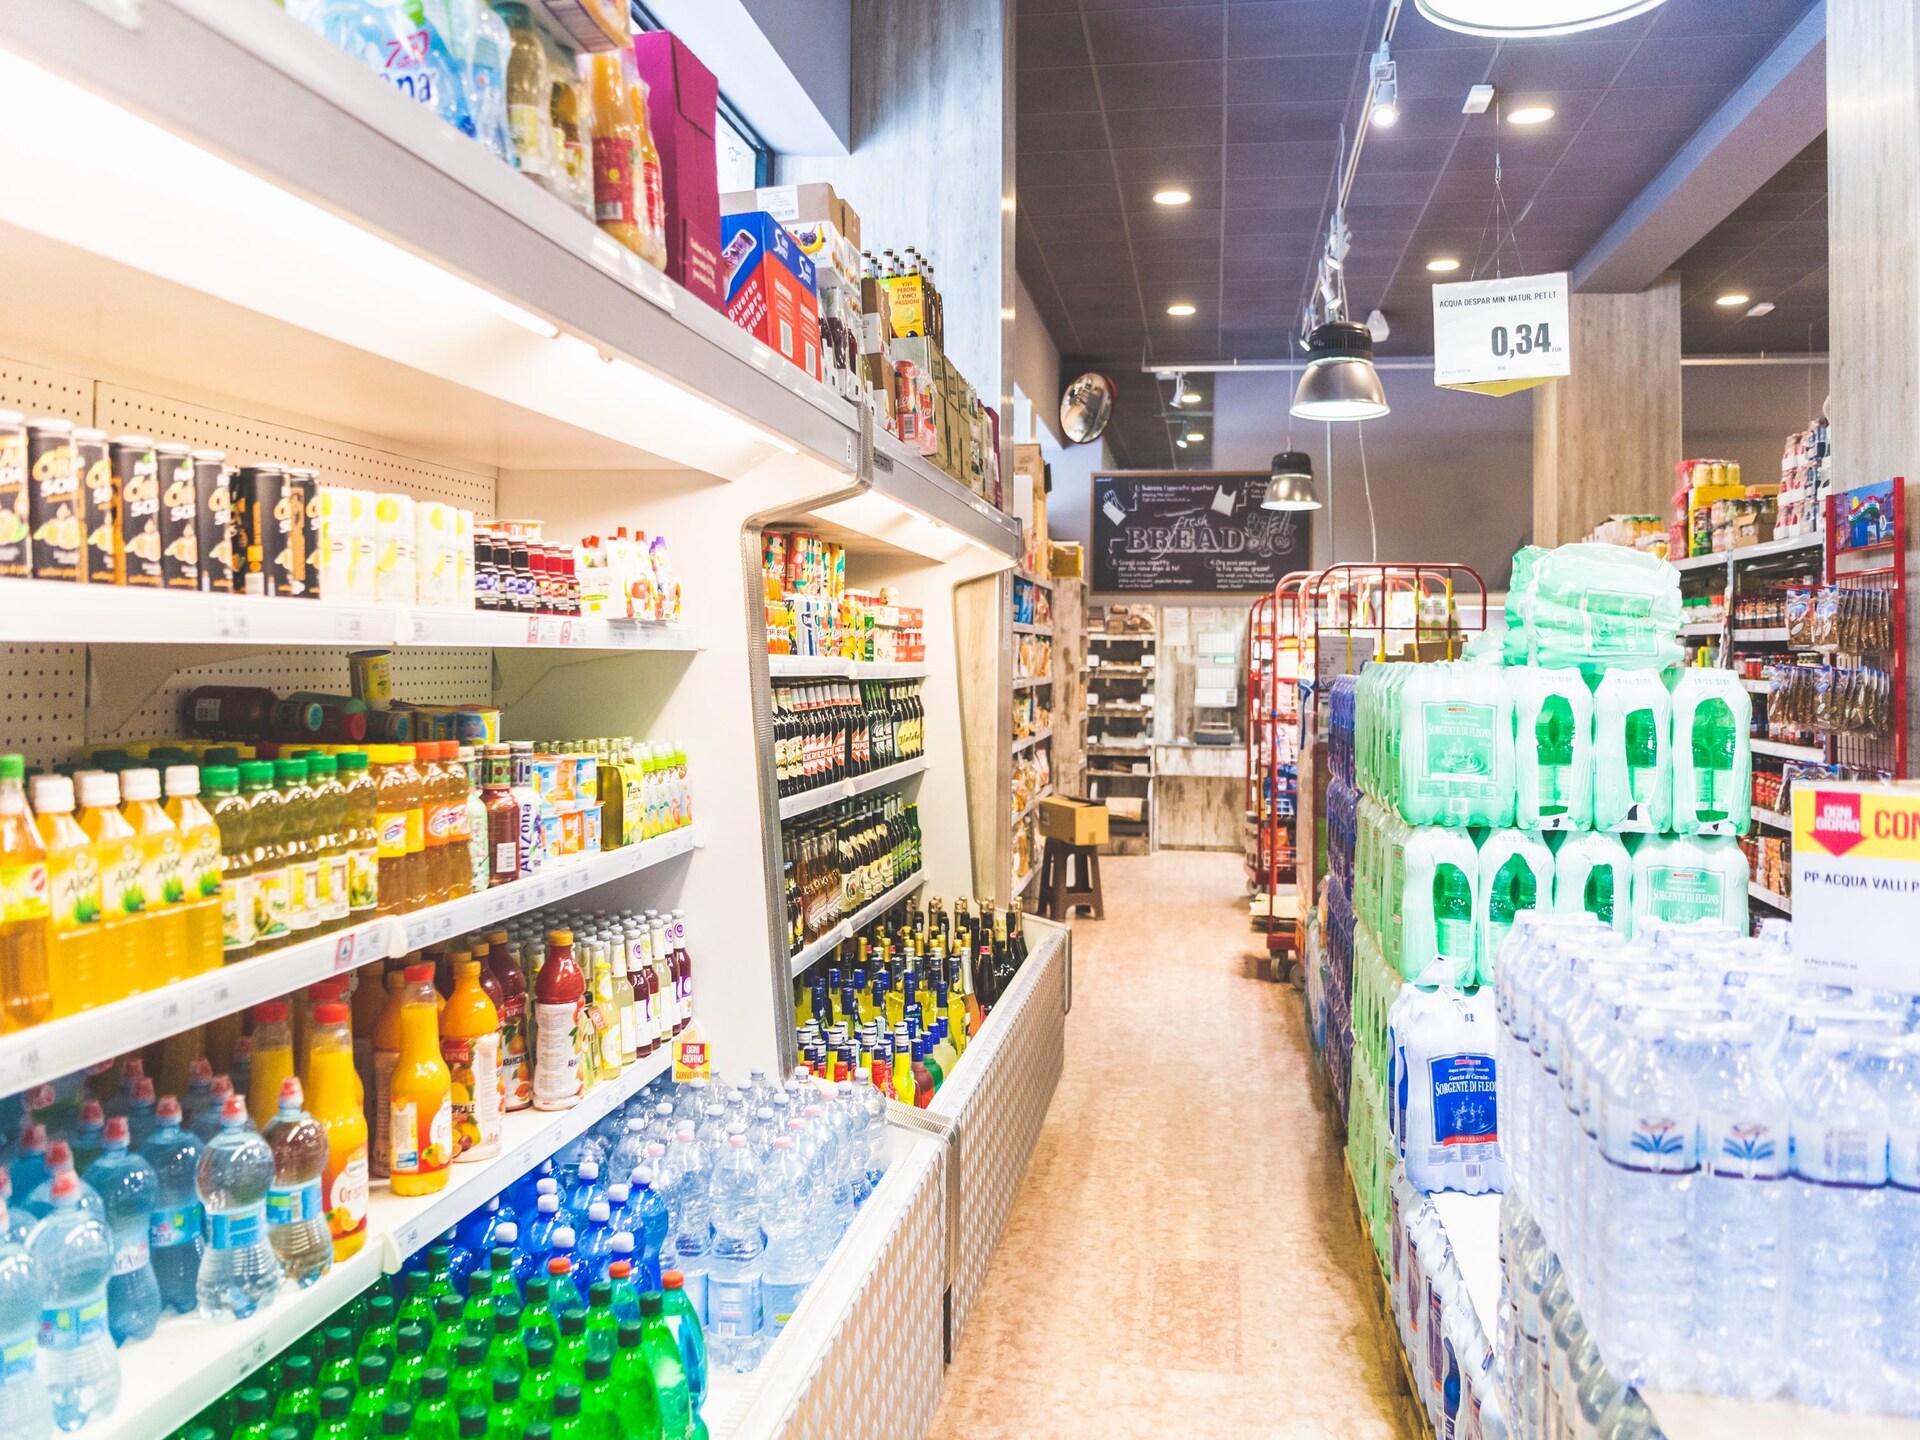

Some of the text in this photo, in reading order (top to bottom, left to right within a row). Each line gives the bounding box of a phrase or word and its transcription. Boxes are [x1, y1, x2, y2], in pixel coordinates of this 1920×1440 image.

[728, 280, 758, 321] Diverso
[1439, 299, 1463, 308] ACQUA
[1464, 297, 1491, 306] DESPAR
[1508, 293, 1532, 303] NATUR.
[1534, 291, 1547, 300] PET
[1548, 290, 1557, 299] LT
[736, 292, 763, 327] empre
[1491, 322, 1552, 359] 0,34
[1125, 527, 1246, 553] BREAD
[1428, 722, 1460, 736] SORGENTE
[1823, 804, 1852, 819] OGNI
[1815, 817, 1861, 834] GIORNO
[155, 856, 183, 879] Aloe
[192, 850, 219, 872] Aloe
[114, 864, 142, 886] Aloe
[65, 872, 98, 897] Aloe
[1872, 877, 1908, 892] VALLI
[1653, 888, 1685, 902] SORGENTE
[686, 1045, 700, 1054] OGNI
[682, 1054, 704, 1064] GIORNO
[1435, 1081, 1469, 1097] SORGENTE
[1469, 1081, 1477, 1092] DI
